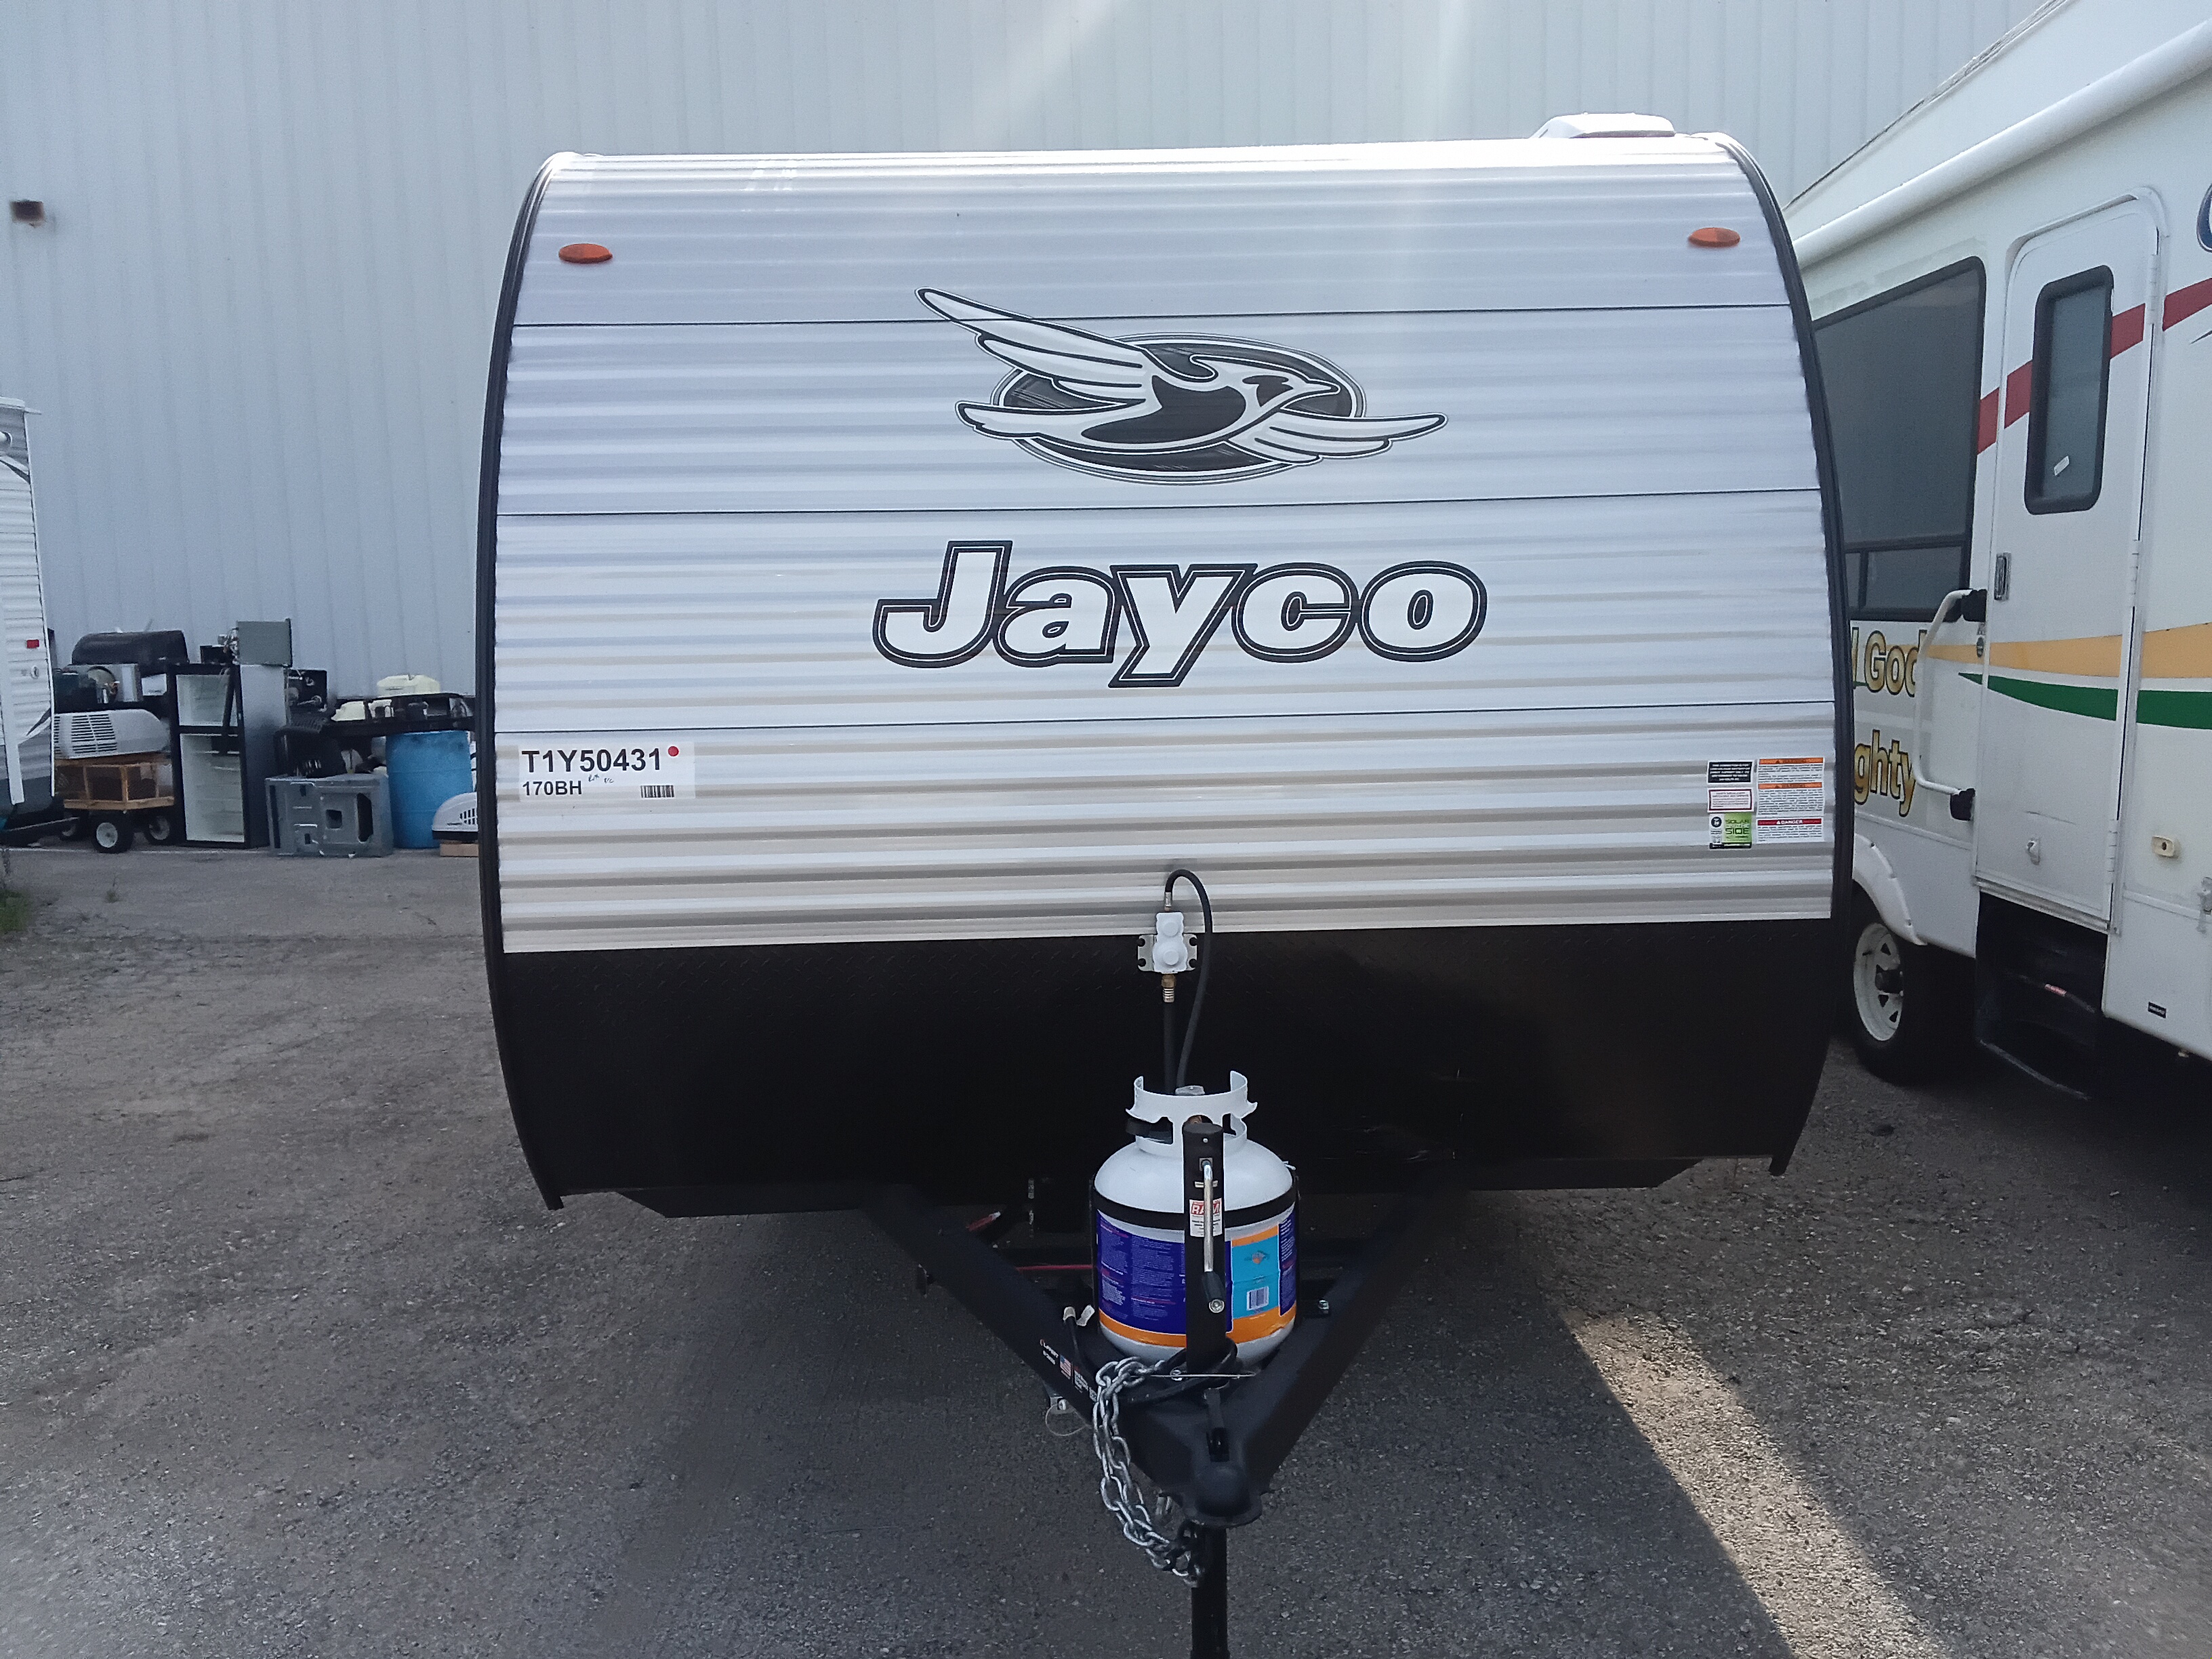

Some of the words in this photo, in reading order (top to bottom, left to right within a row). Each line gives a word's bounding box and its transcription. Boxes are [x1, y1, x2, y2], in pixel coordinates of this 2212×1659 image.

[872, 539, 1488, 687] Jayco
[521, 747, 661, 773] T1Y50431
[522, 780, 583, 796] 170BH
